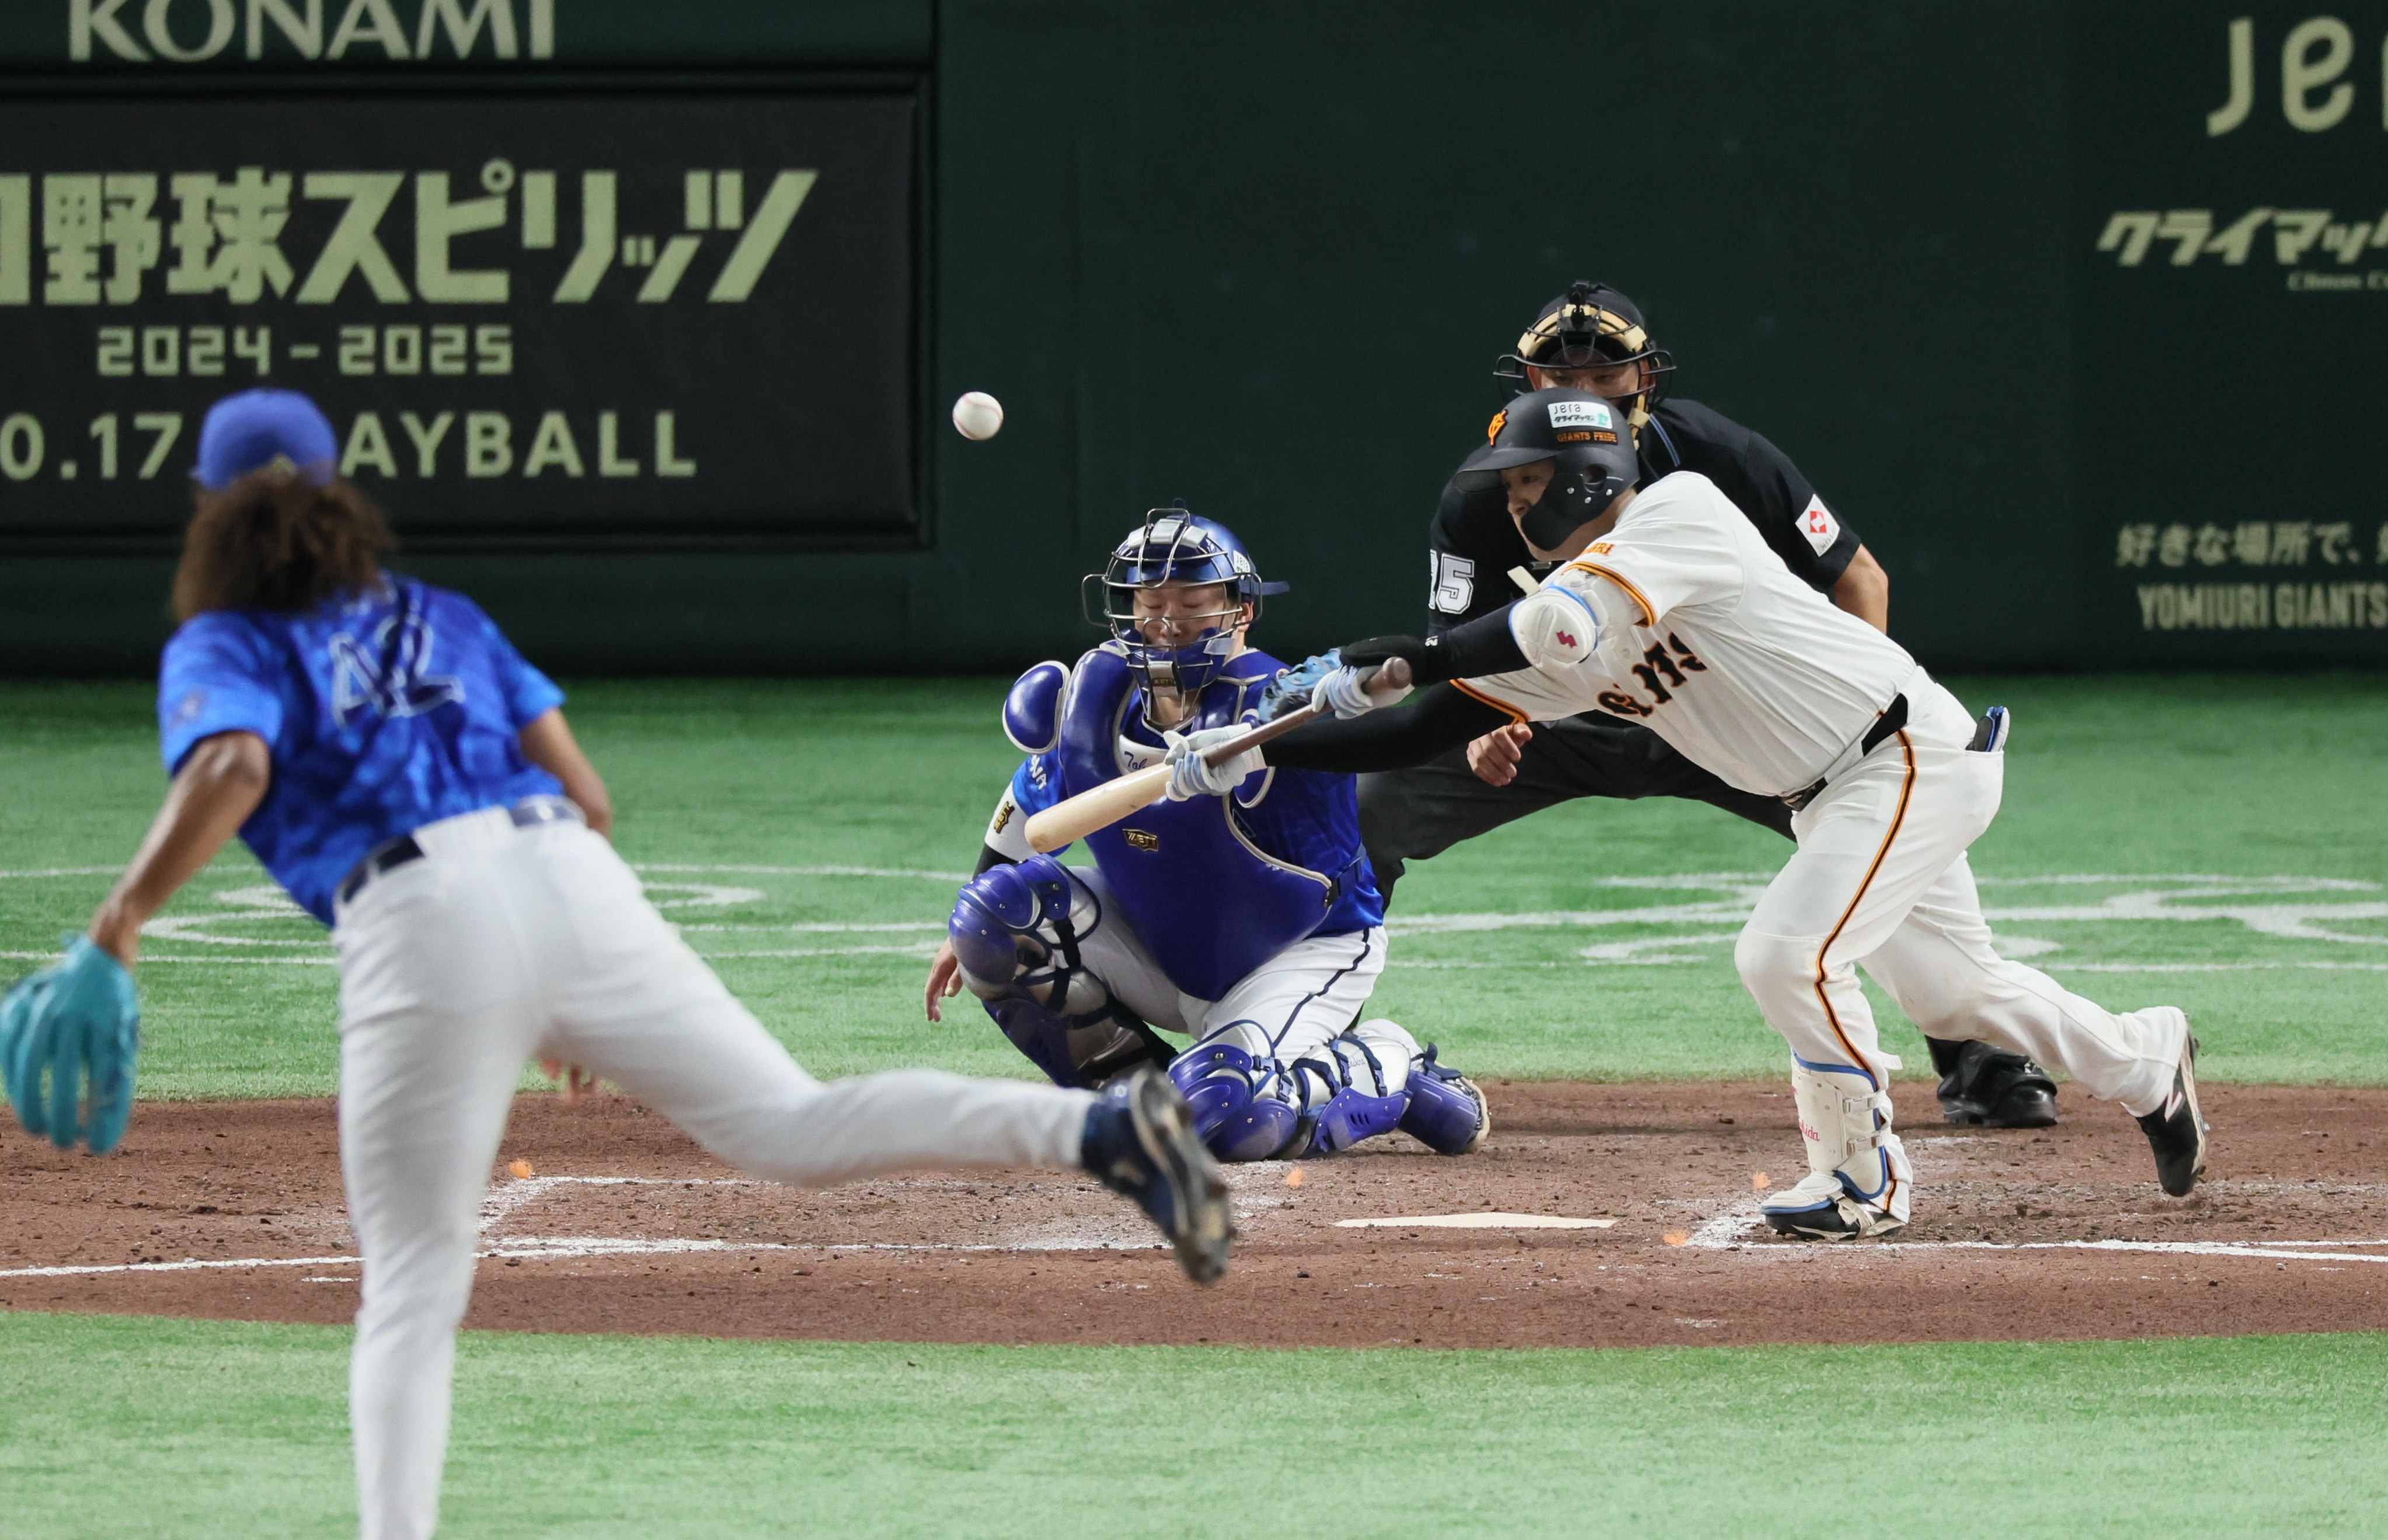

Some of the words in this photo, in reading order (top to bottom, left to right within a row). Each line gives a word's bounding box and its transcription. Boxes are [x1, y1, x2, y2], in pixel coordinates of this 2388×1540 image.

[69, 0, 554, 61] KONAMI
[2207, 16, 2388, 135] Je
[340, 411, 697, 478] AYBALL
[1557, 431, 1591, 443] GIANTS
[2117, 521, 2388, 567] 好きな場所で、
[2137, 583, 2270, 630] YOMIURI
[2274, 582, 2388, 629] GIANTS
[1127, 831, 1157, 846] ZETT
